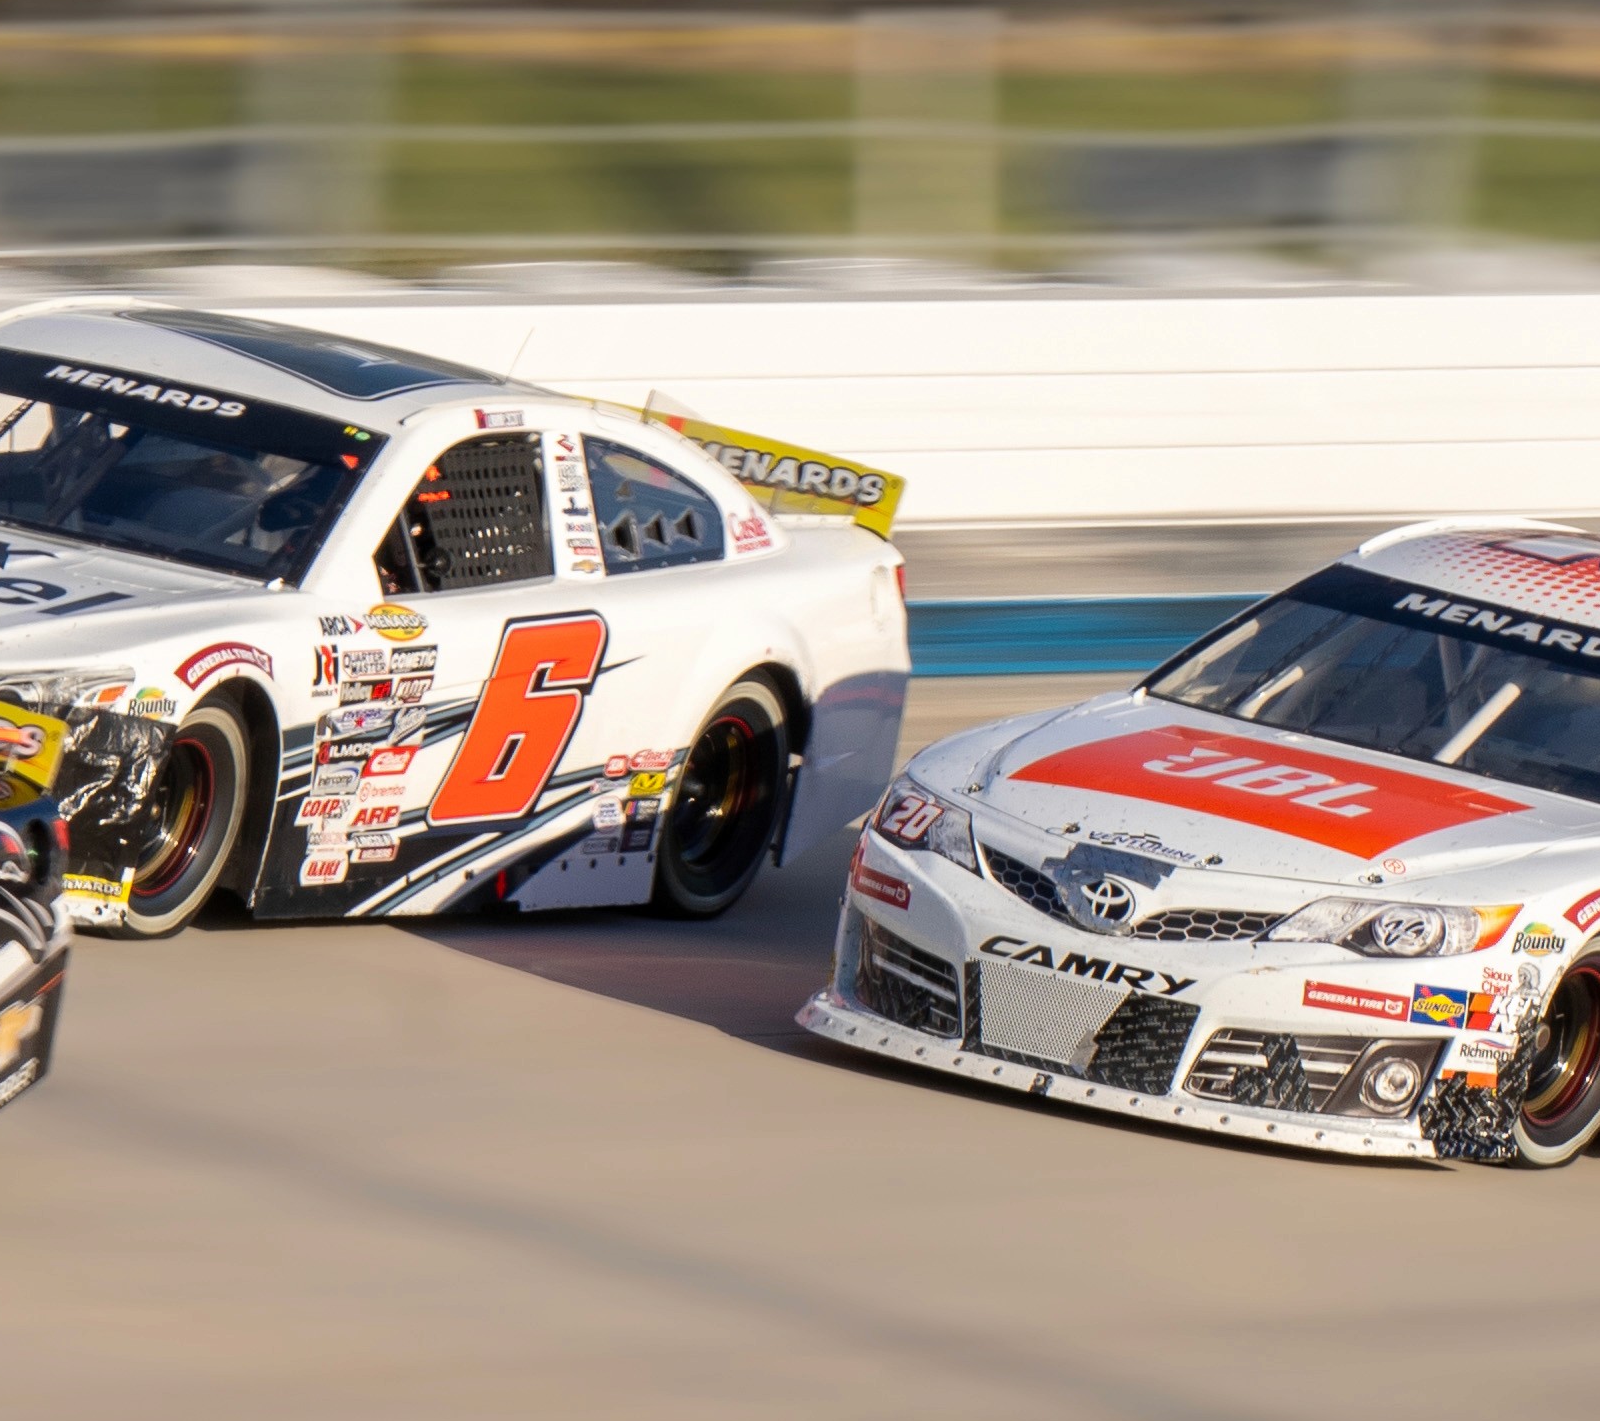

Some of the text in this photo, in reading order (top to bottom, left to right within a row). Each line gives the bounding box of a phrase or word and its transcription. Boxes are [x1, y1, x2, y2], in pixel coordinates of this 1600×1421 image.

[45, 365, 246, 417] MENARDS
[319, 613, 429, 636] ARCA MENARDS
[187, 647, 234, 684] GENERAL
[344, 651, 384, 667] QUARTER
[352, 662, 387, 675] MASTER
[392, 651, 437, 671] COMETIC
[128, 697, 178, 717] Bounty
[427, 609, 609, 831] 6
[371, 785, 406, 797] brembo
[1143, 747, 1378, 818] JBL
[351, 806, 400, 827] ARP
[882, 794, 944, 842] 20
[1511, 932, 1567, 954] Bounty
[979, 935, 1198, 995] CAMRY
[1483, 967, 1513, 983] Sioux
[1482, 980, 1510, 994] Chief
[1308, 990, 1384, 1011] GENERAL TIRE
[1414, 998, 1463, 1016] SUNOCO
